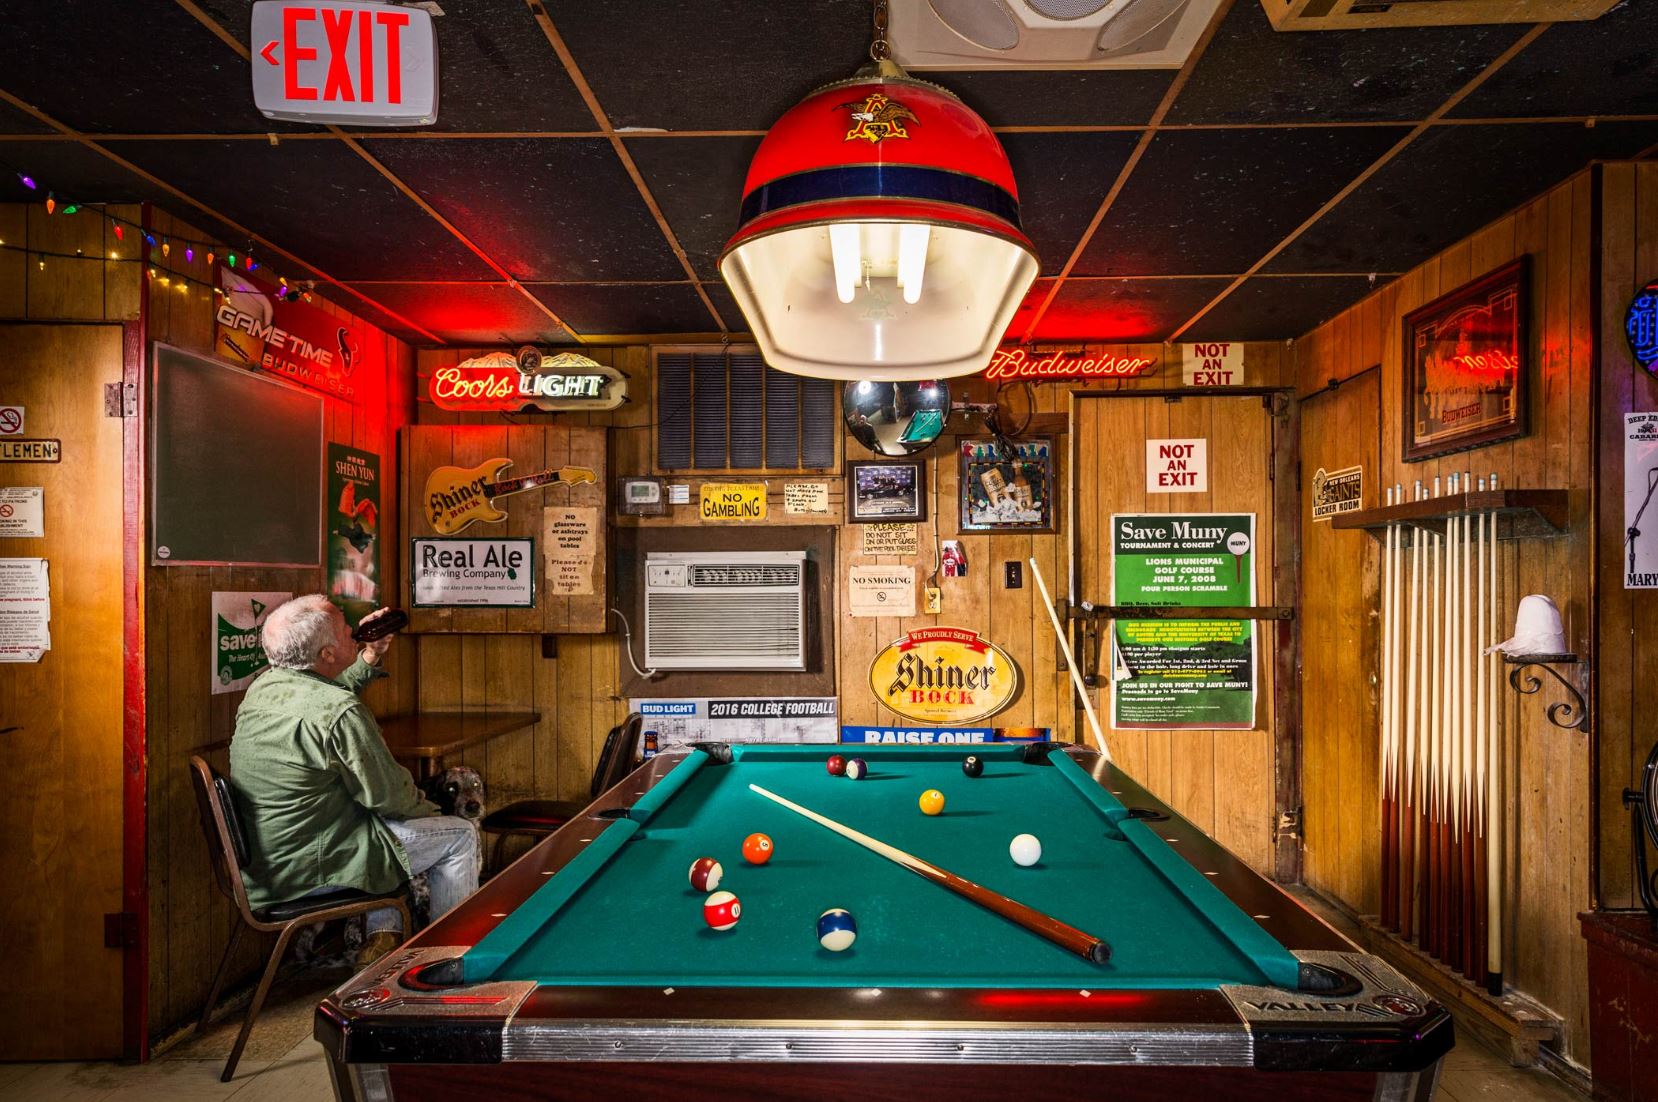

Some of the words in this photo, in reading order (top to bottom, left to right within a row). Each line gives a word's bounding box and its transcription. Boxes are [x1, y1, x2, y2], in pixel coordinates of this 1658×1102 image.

[283, 8, 409, 104] EXIT
[216, 305, 287, 349] GAME
[286, 336, 333, 368] TIME
[1194, 344, 1230, 358] NOT
[985, 350, 1151, 379] Budweiser
[1202, 359, 1222, 370] AN
[262, 353, 354, 395] BUDWEISER
[1193, 371, 1233, 386] EXIT
[436, 368, 514, 398] Coors
[518, 372, 604, 397] LIGHT
[1442, 402, 1480, 424] BUDWEISER
[1628, 416, 1646, 424] DEEP
[1159, 444, 1194, 458] NOT
[336, 461, 358, 477] SHEN
[358, 466, 374, 480] YUN
[1167, 460, 1187, 470] AN
[1158, 472, 1198, 486] EXIT
[1340, 474, 1360, 483] ORLEANS
[430, 476, 486, 524] Shiner
[722, 494, 742, 502] NO
[450, 499, 480, 518] BOCK
[704, 496, 760, 517] GAMBLING
[1314, 504, 1336, 516] LOCKER
[1338, 500, 1360, 512] ROOM
[1121, 522, 1166, 540] Save
[1171, 521, 1228, 544] Muny
[422, 544, 475, 568] Real
[483, 544, 523, 568] Ale
[423, 568, 460, 579] Brewing
[463, 568, 506, 579] Company
[1178, 576, 1188, 584] 7,
[220, 634, 256, 651] save
[912, 632, 922, 640] WE
[953, 631, 974, 641] SERVE
[888, 652, 996, 696] Shiner
[909, 690, 974, 704] BOCK
[642, 704, 663, 713] BUD
[664, 704, 694, 713] LIGHT
[711, 704, 738, 715] 2016
[740, 703, 783, 715] COLLEGE
[786, 702, 834, 714] FOOTBALL
[864, 731, 934, 743] RAISE
[938, 732, 984, 743] ONE
[1244, 1001, 1353, 1012] VALLEY
